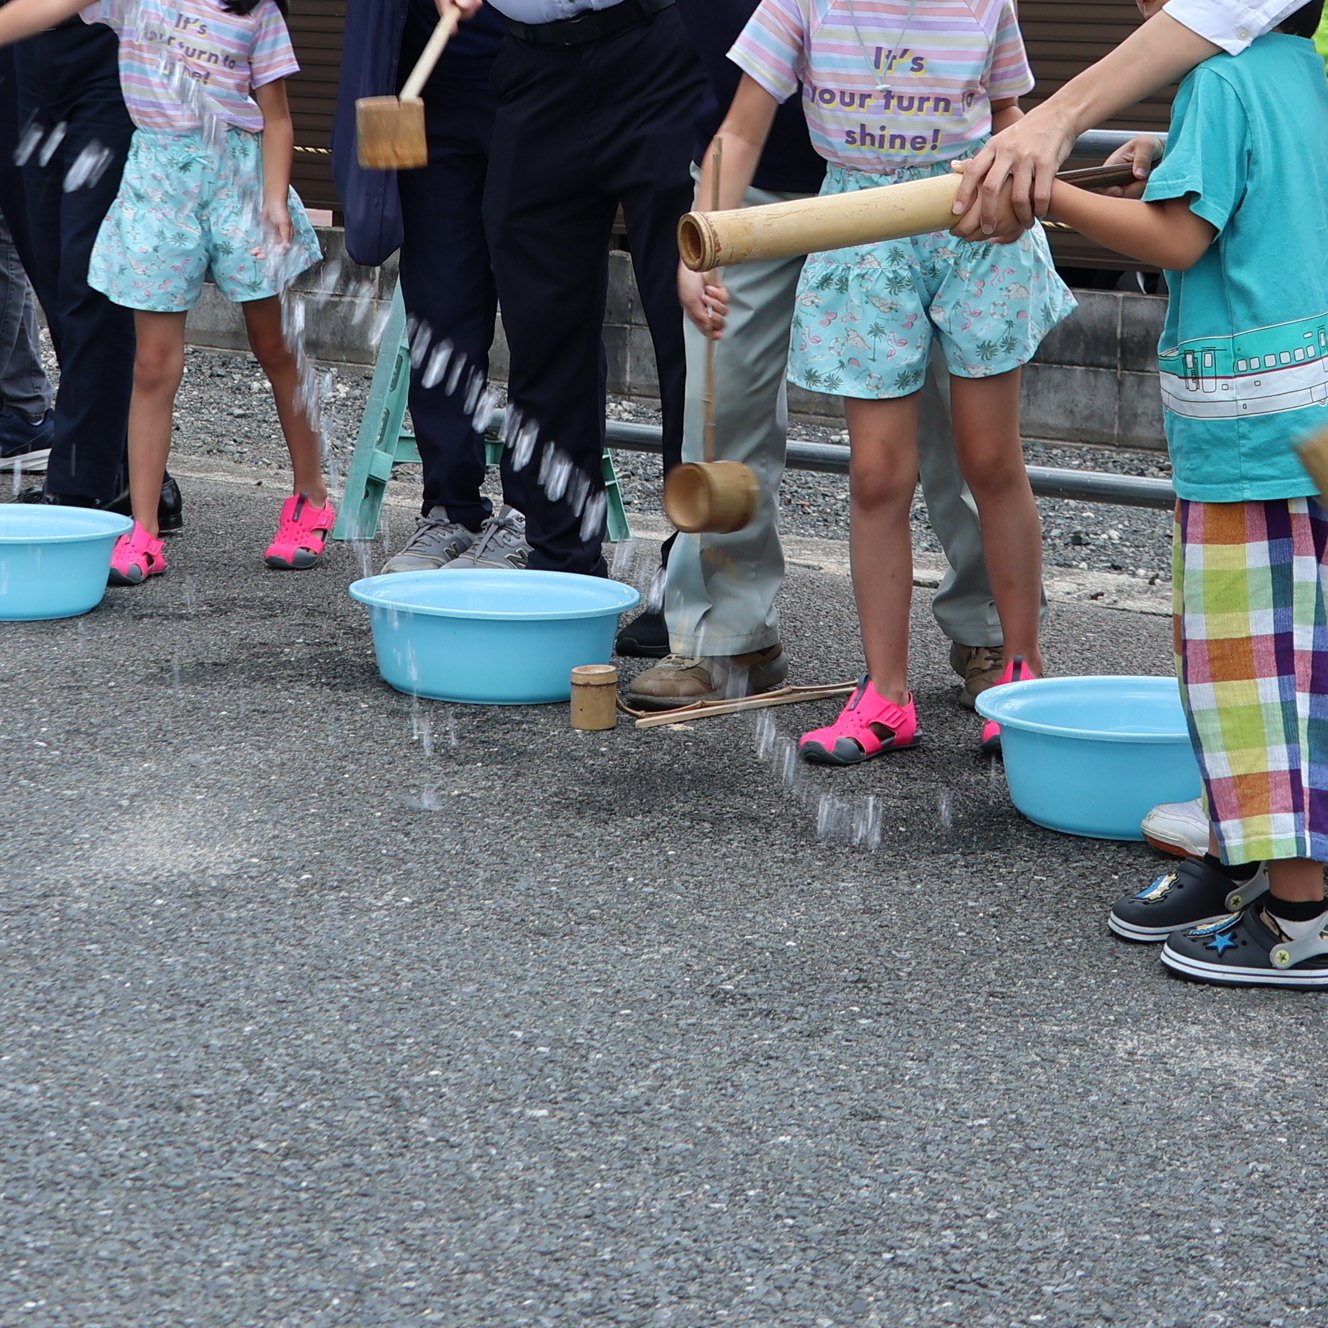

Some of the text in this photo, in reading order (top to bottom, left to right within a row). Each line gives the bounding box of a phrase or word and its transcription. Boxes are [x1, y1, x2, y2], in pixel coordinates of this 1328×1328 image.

[175, 13, 209, 36] It's
[223, 55, 237, 71] to
[874, 46, 926, 75] It's
[883, 90, 952, 115] turn
[844, 123, 941, 153] shine!
